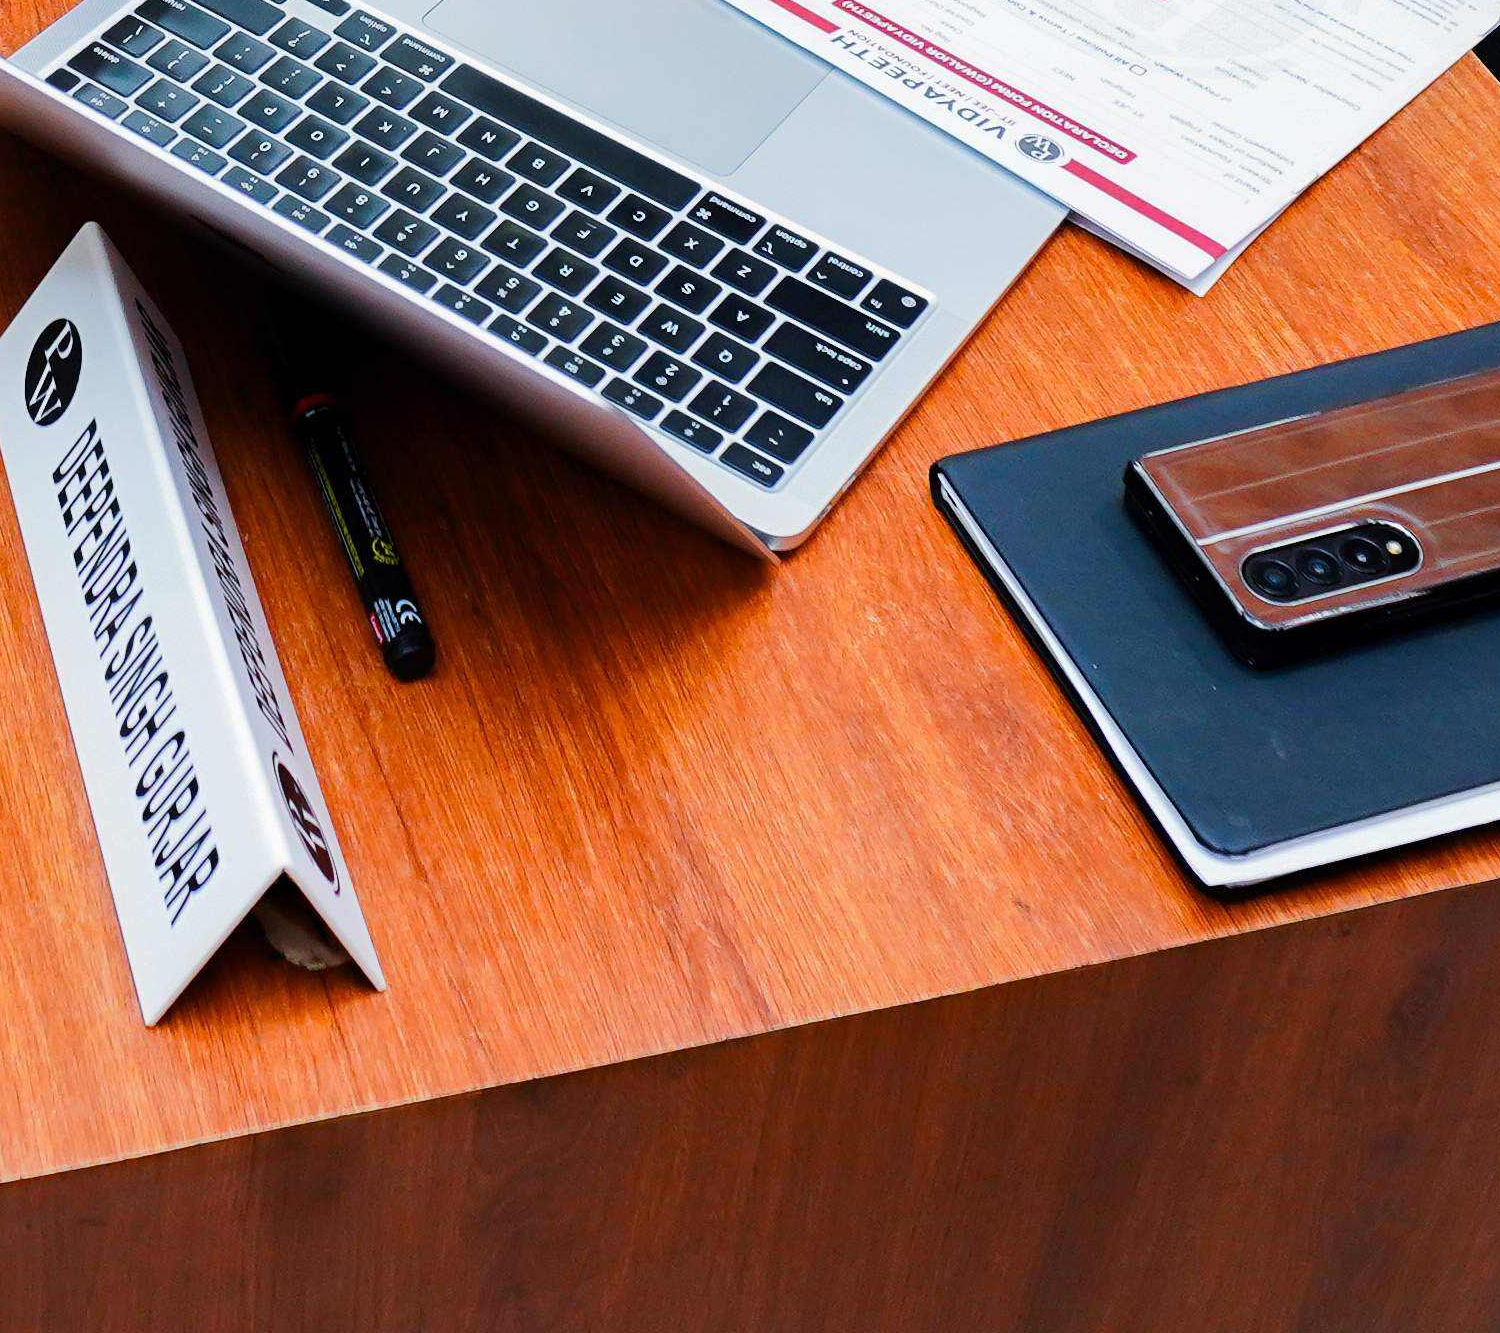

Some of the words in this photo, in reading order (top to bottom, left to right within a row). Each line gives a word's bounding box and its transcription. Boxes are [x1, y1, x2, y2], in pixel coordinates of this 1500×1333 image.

[359, 13, 387, 34] option
[1036, 13, 1070, 34] Terms
[402, 38, 445, 63] command
[844, 28, 929, 76] FOUNDATION
[923, 44, 994, 86] (GWALIOR
[829, 33, 1006, 140] VIDYAPEETH
[932, 77, 966, 98] NEET
[988, 80, 1034, 108] FORM
[1029, 103, 1128, 159] DECLARATION
[708, 196, 757, 224] command
[775, 229, 808, 249] option
[827, 256, 864, 279] control
[865, 319, 890, 338] shift
[26, 320, 74, 425] PW
[815, 391, 833, 406] tab
[752, 460, 772, 475] esc
[52, 418, 145, 659] DEEPENDRA
[104, 615, 179, 768] SINGH
[136, 731, 221, 929] GURJAR
